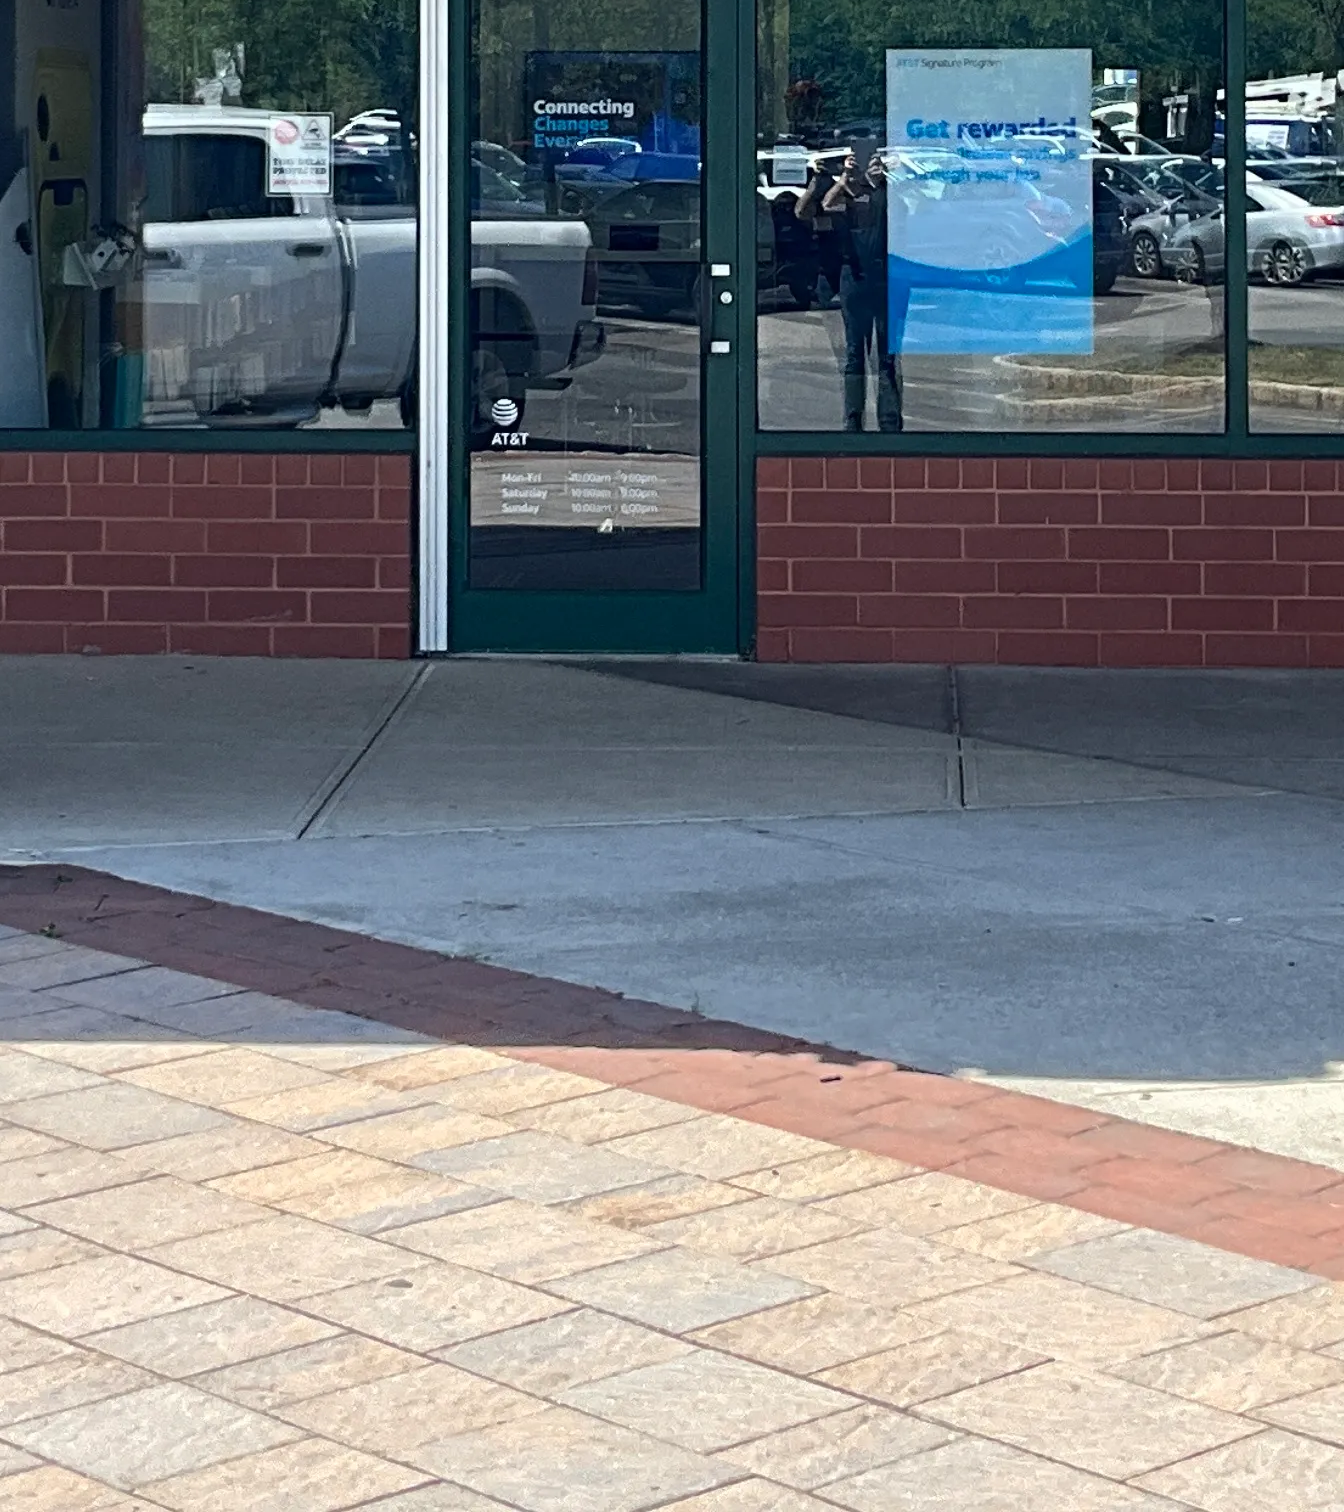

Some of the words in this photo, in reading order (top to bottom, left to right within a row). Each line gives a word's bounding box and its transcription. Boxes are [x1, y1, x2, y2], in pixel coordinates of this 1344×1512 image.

[533, 99, 634, 118] Connecting
[534, 116, 609, 134] Changes
[906, 118, 950, 139] Get
[957, 117, 1077, 139] rewarded
[491, 432, 530, 446] AT&T
[501, 488, 548, 500] Saturday
[501, 502, 539, 515] Sunday
